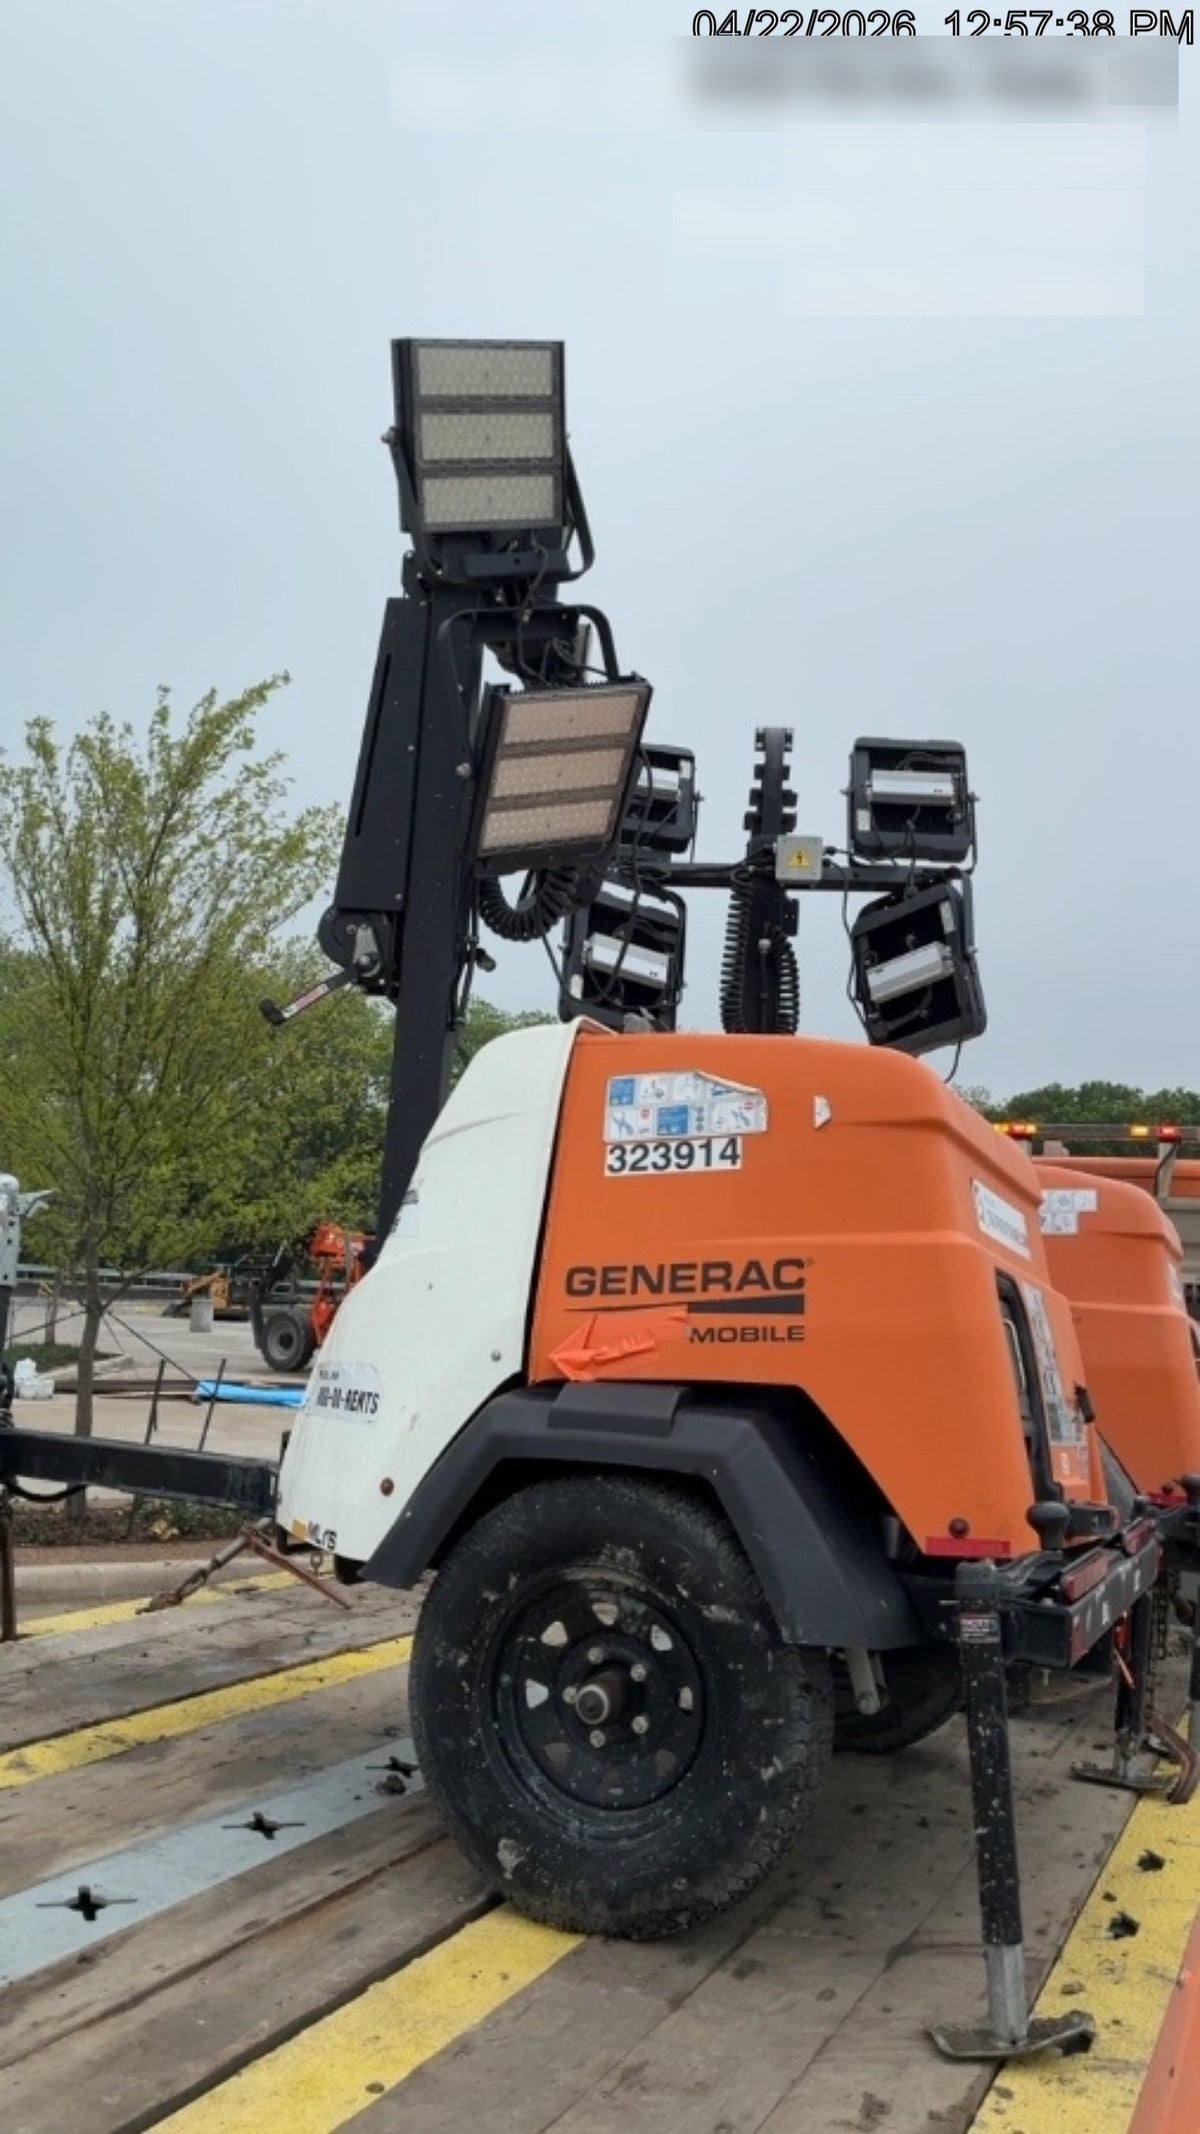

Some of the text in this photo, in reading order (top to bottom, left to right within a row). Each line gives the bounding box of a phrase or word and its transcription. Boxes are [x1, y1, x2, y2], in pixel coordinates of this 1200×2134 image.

[606, 1136, 741, 1174] 323914
[565, 1258, 806, 1297] GENERAC
[689, 1325, 806, 1344] MOBILE
